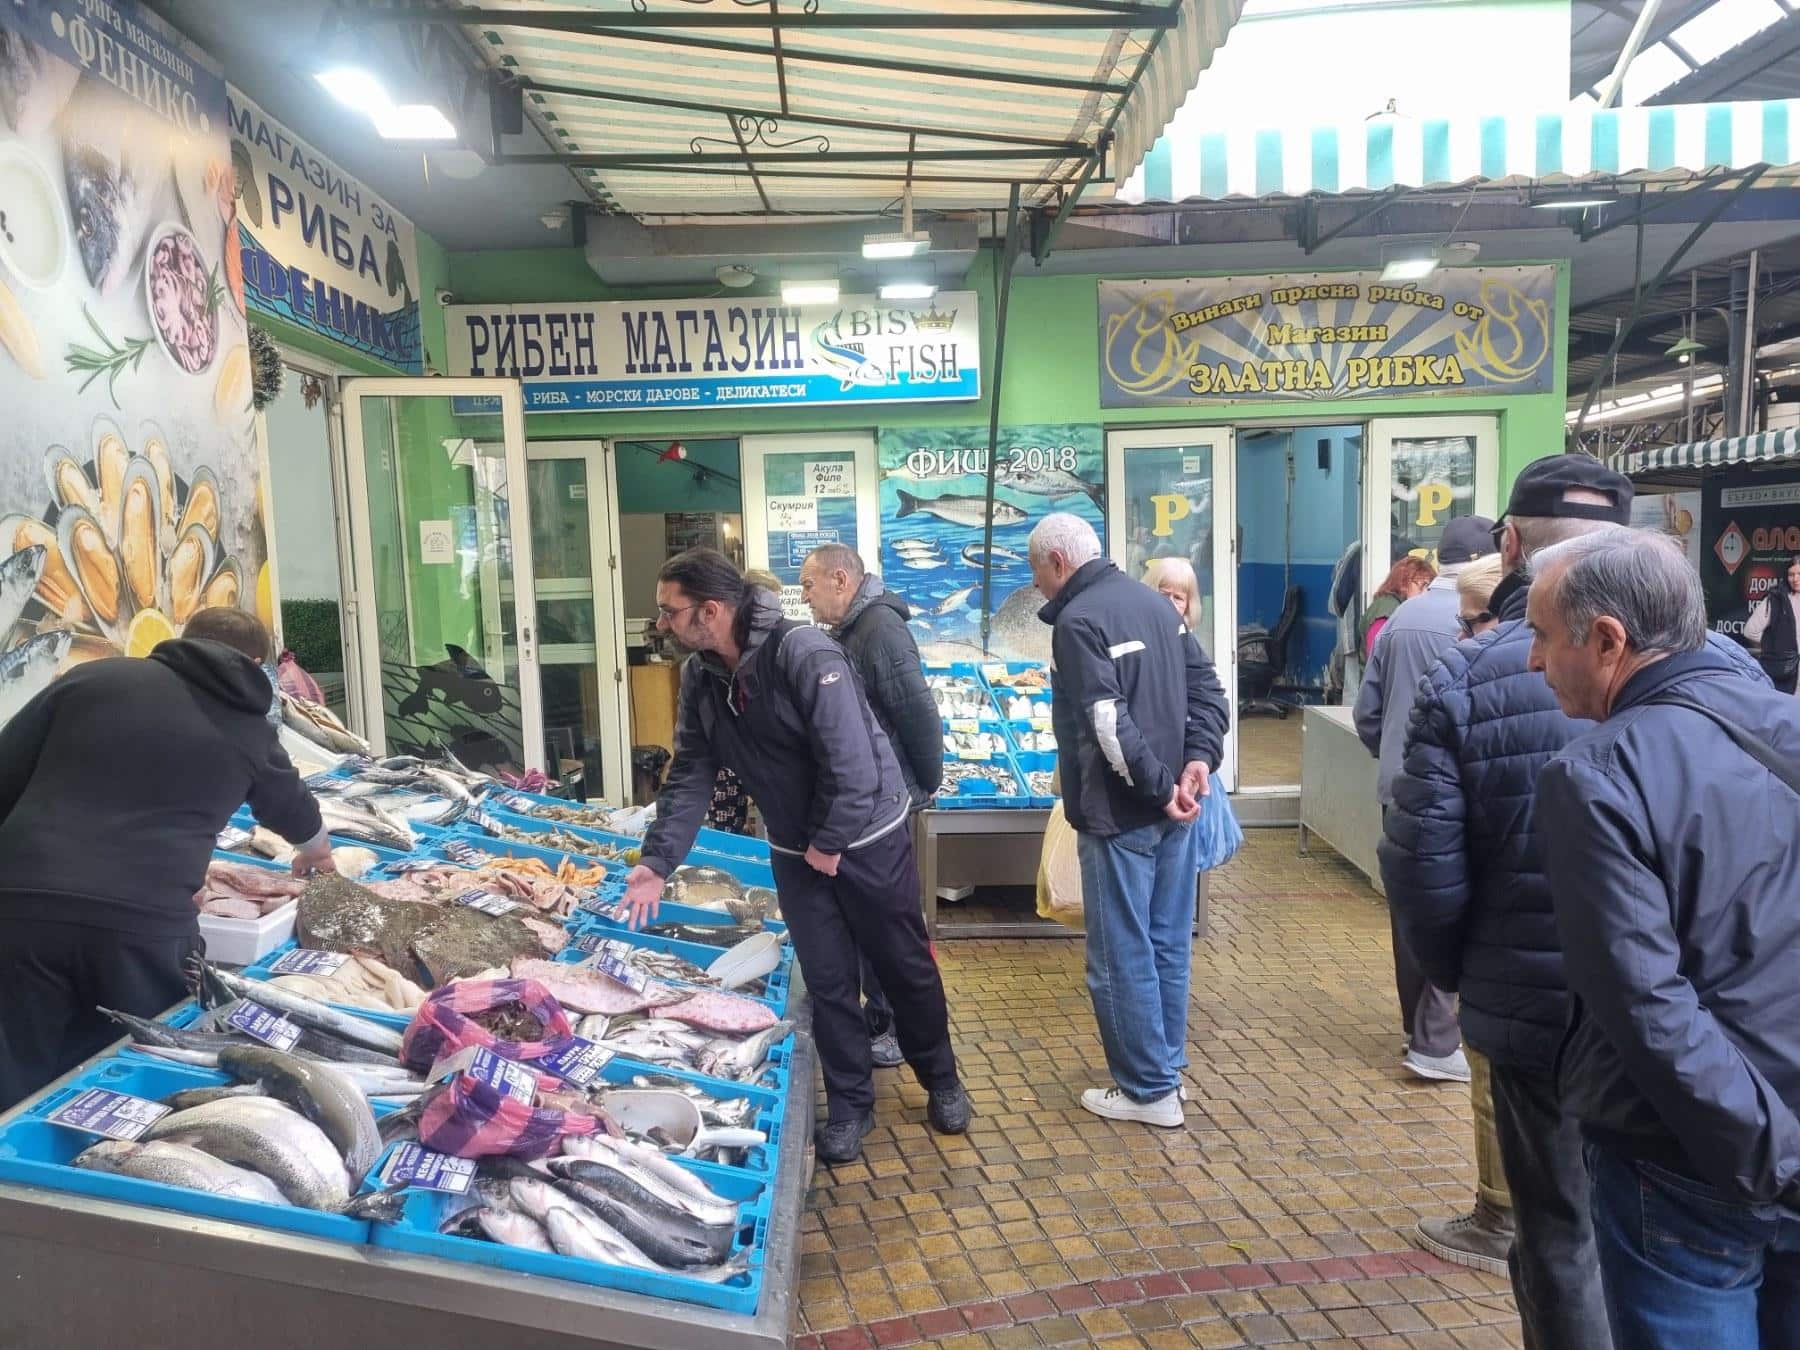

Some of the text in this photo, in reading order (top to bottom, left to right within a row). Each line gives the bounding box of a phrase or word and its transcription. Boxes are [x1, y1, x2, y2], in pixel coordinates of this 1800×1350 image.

[226, 96, 399, 241] МАГАЗИН ЗА
[267, 172, 383, 287] РИБА
[1170, 283, 1484, 333] Винаги прясна рибка от
[851, 308, 907, 337] BIS
[1267, 323, 1388, 346] Магазин
[466, 307, 804, 377] РИБЕН МАГАЗИН
[888, 343, 961, 381] FISH
[1189, 354, 1465, 395] ЗЛАТНА РИБКА
[532, 392, 570, 404] РИБА
[586, 390, 642, 403] МОРСКИ
[646, 388, 700, 403] ДАРОВЕ
[716, 384, 807, 401] ДЕЛИКАТЕСИ
[813, 463, 843, 474] Акула
[906, 446, 1078, 479] ФИШ 2018
[814, 484, 826, 494] 12
[815, 473, 842, 482] Филе
[769, 500, 814, 513] Скумрия
[1750, 577, 1779, 593] ДОМ
[1716, 620, 1745, 635] ДОСТ
